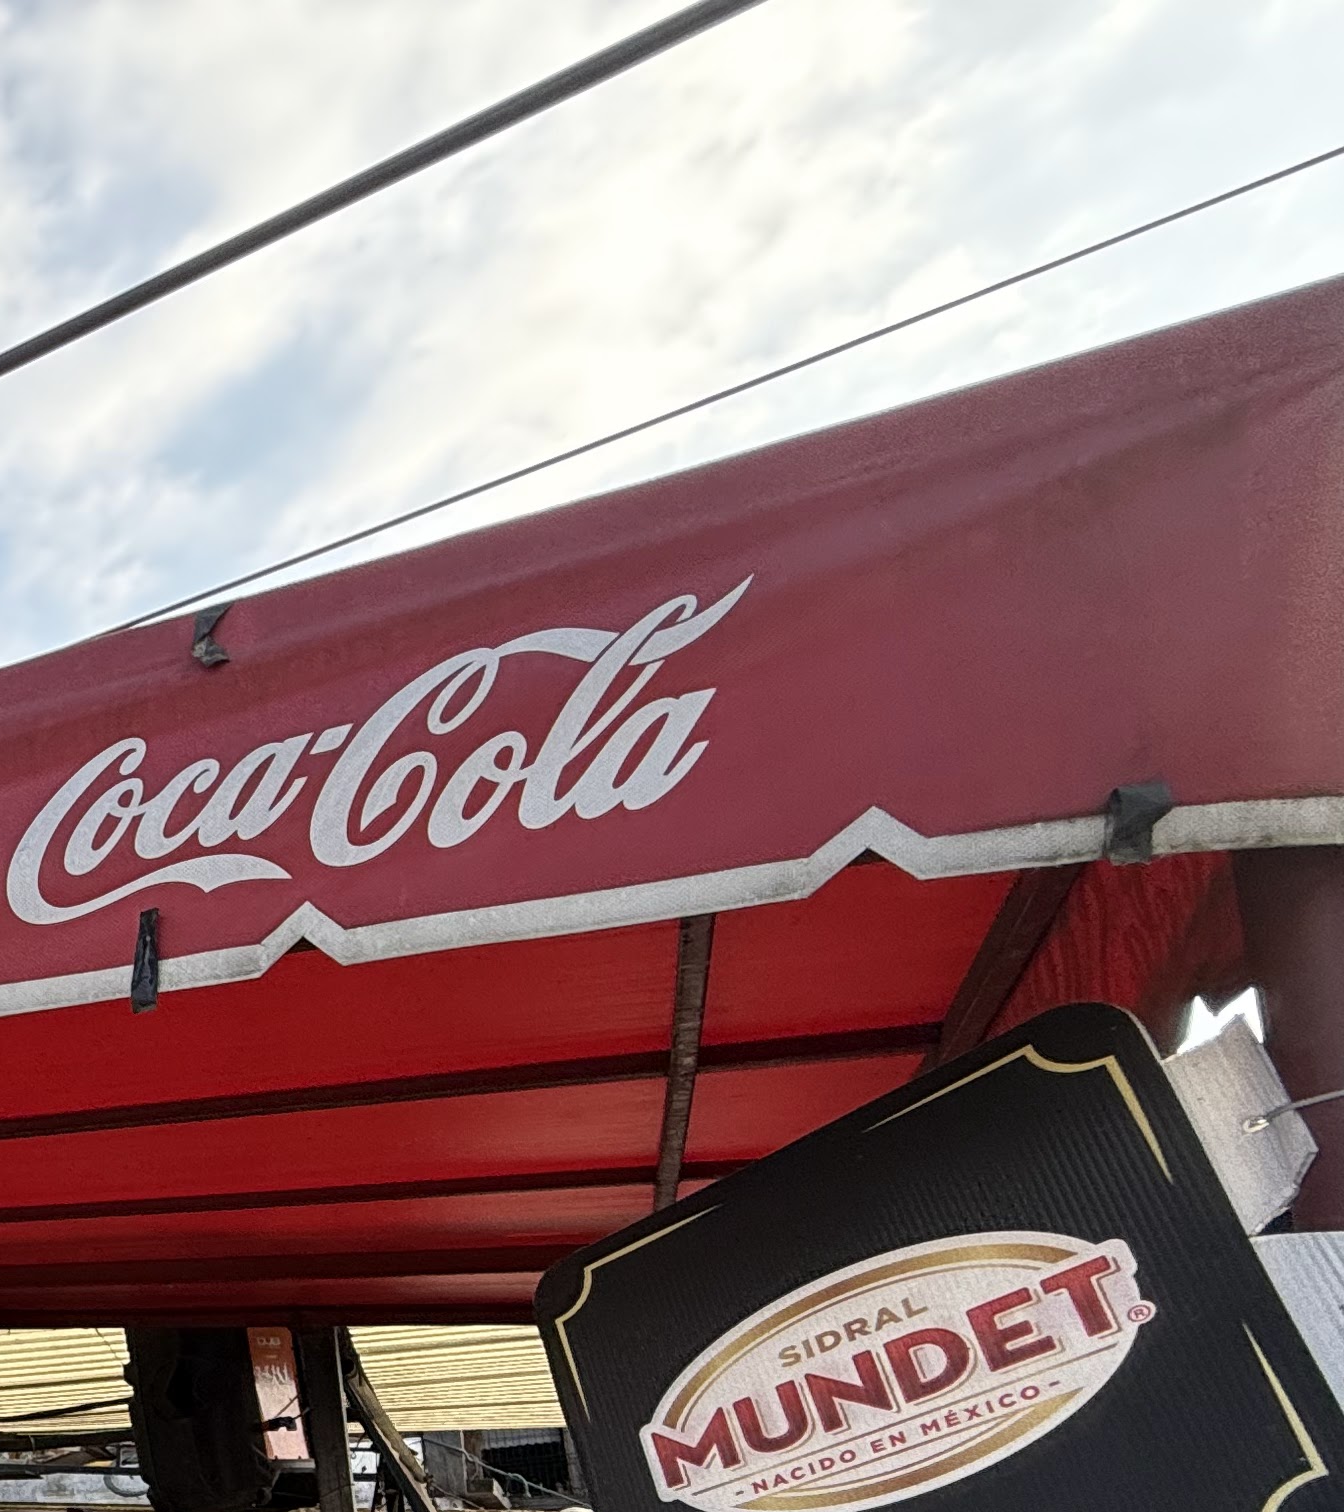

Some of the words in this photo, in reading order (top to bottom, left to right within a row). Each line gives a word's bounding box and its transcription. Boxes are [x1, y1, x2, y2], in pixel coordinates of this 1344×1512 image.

[6, 573, 754, 925] Coca-Cola
[651, 1255, 1122, 1490] MUNDET
[778, 1298, 929, 1368] SIDRAL
[752, 1449, 857, 1497] NACIDO
[870, 1431, 907, 1454] EN
[921, 1385, 1040, 1438] MÉXICO
